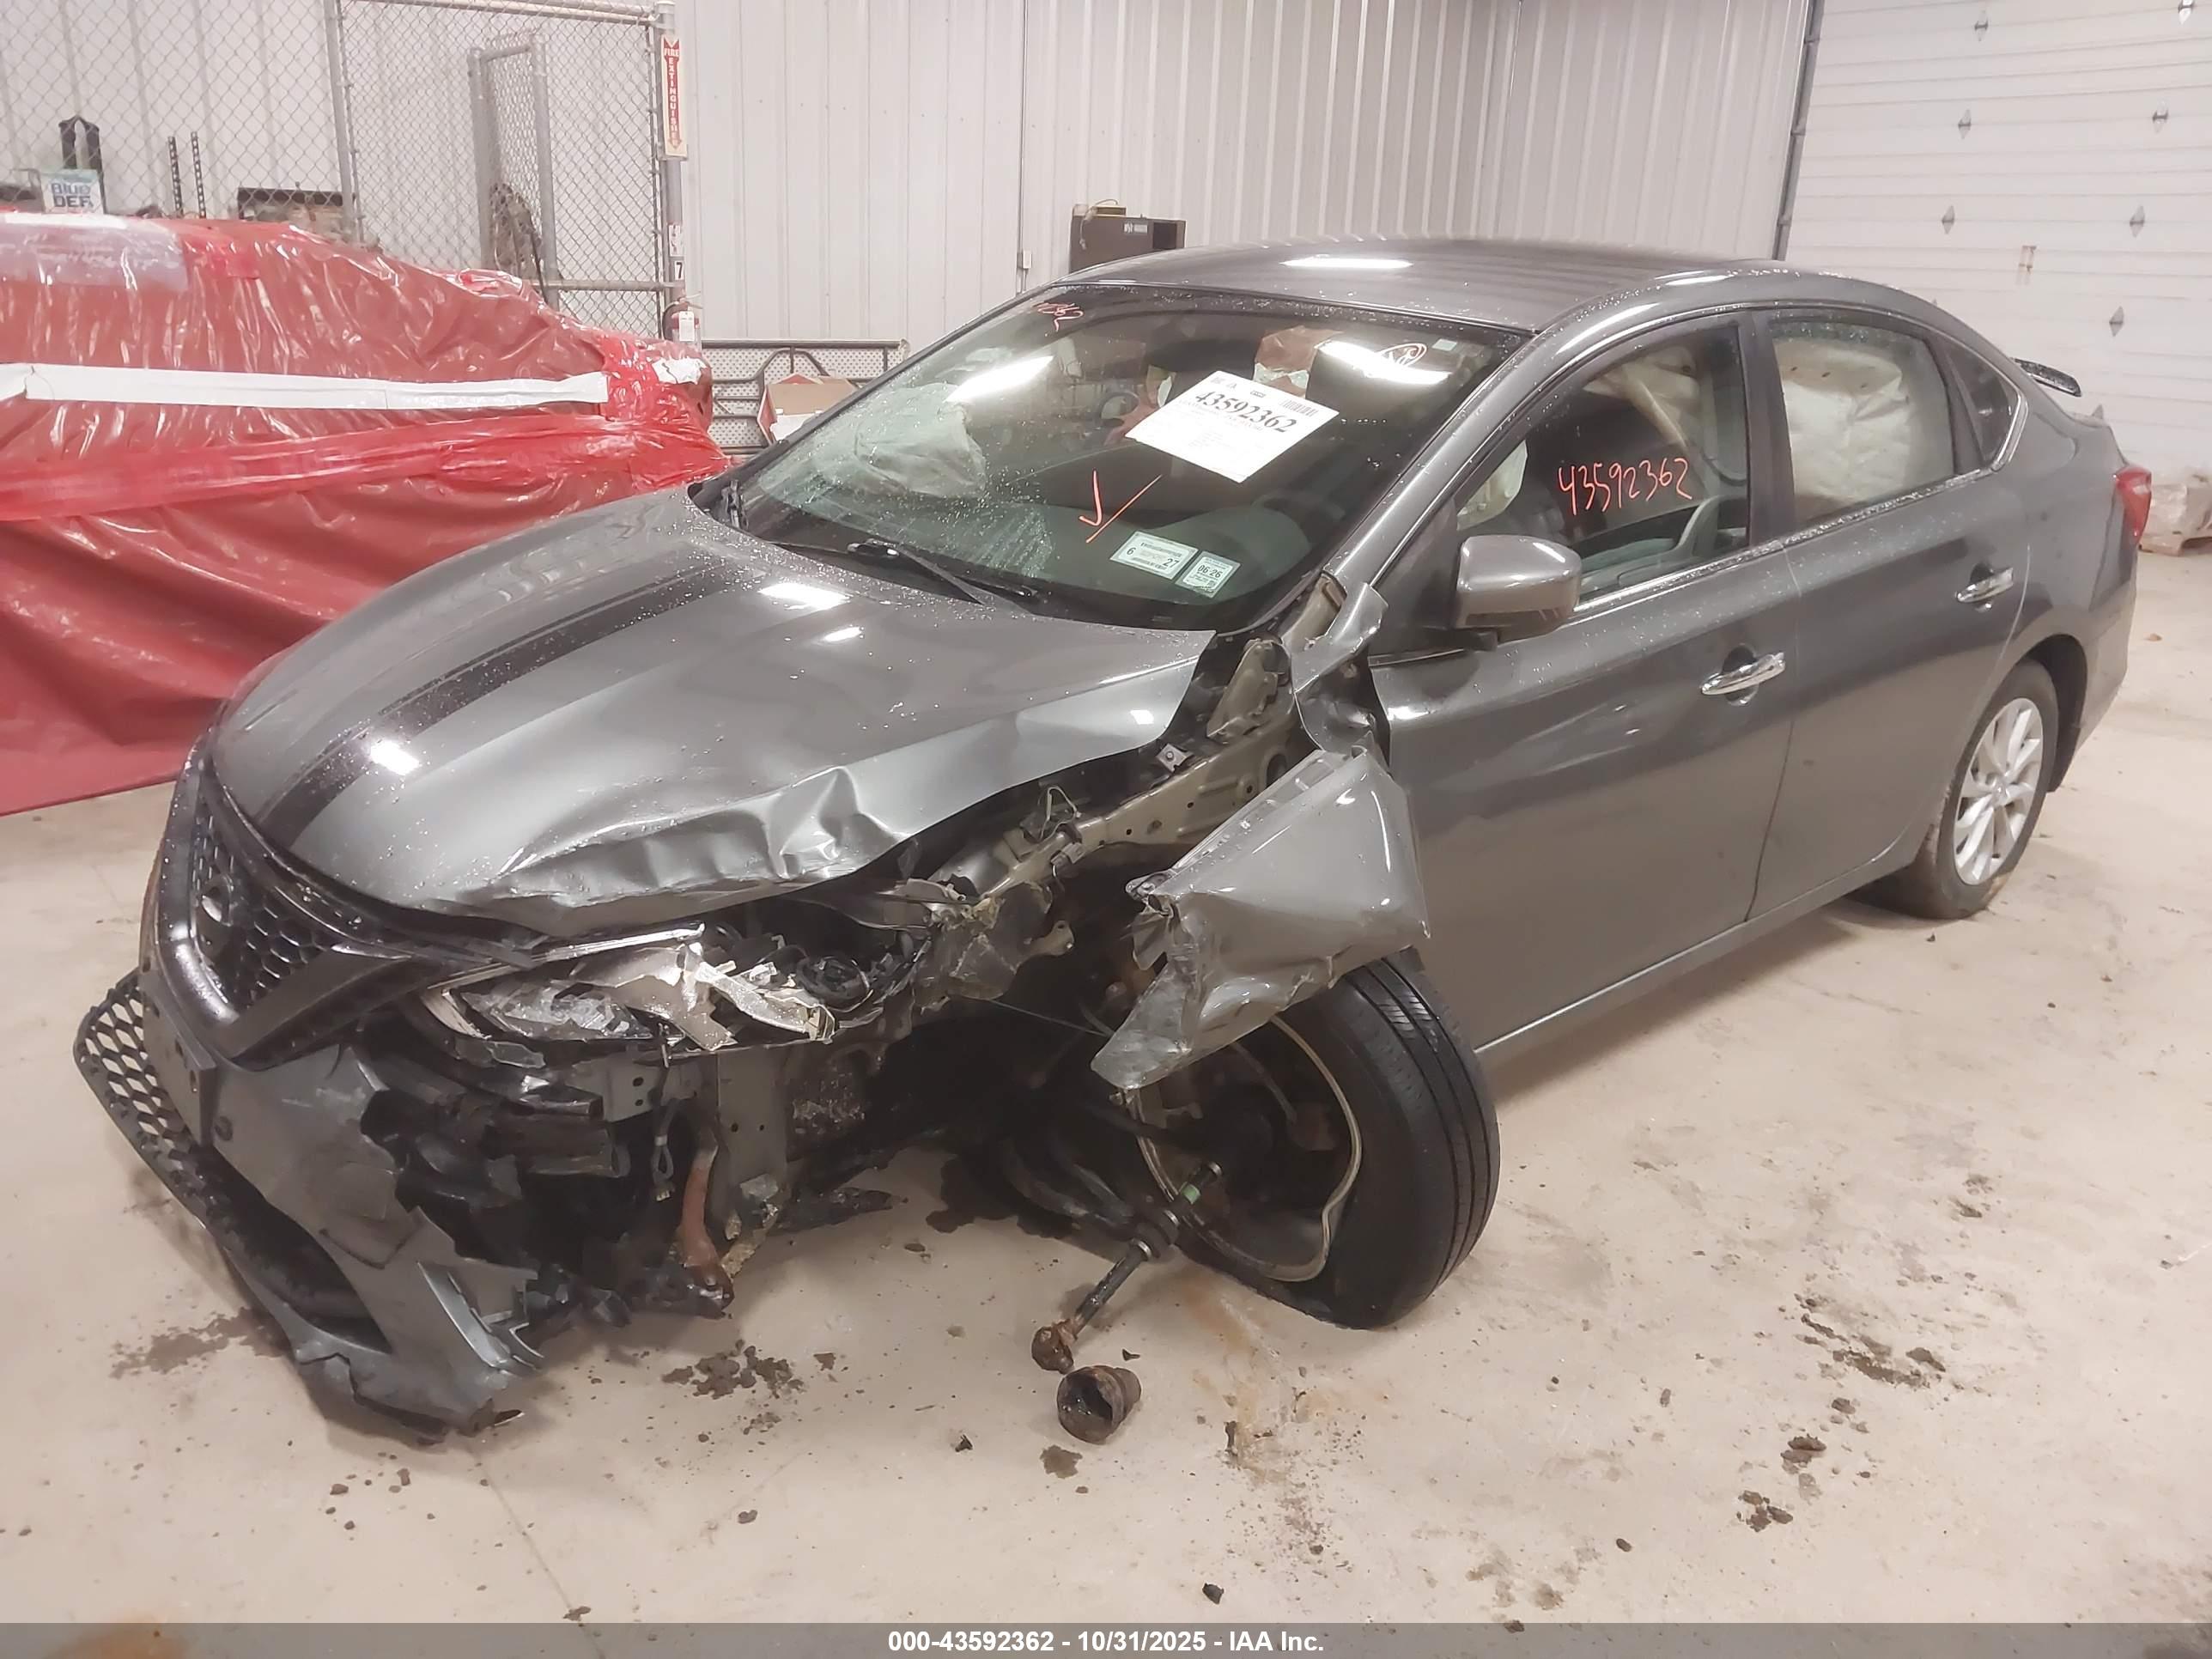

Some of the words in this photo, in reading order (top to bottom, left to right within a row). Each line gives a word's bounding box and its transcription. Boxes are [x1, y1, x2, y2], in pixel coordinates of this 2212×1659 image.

[664, 48, 679, 58] FIRE
[51, 182, 91, 195] Blue
[676, 262, 683, 279] 7
[1194, 391, 1298, 434] 43592362
[1558, 457, 1692, 516] 43592362
[1126, 546, 1137, 556] 6
[1163, 557, 1180, 568] 27
